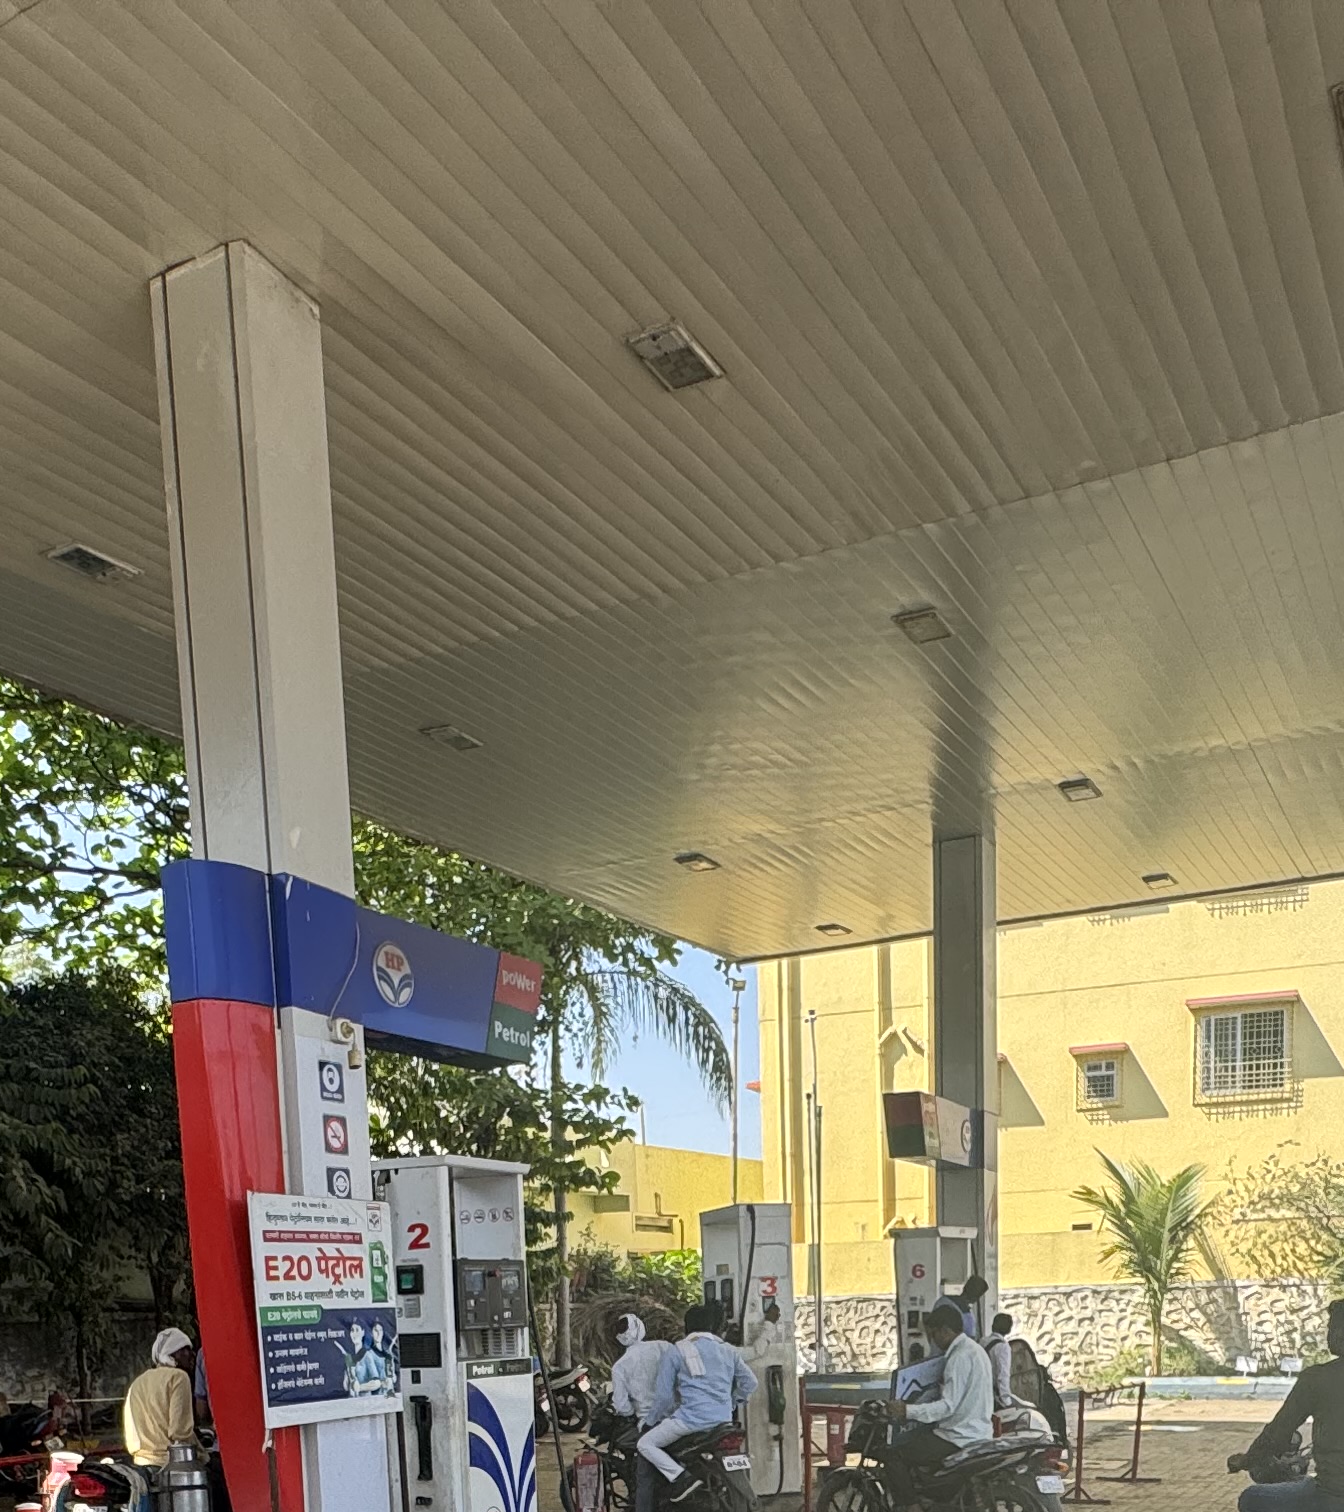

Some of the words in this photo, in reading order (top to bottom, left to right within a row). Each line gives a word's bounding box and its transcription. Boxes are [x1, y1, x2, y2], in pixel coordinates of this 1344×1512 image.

[383, 951, 405, 971] HP
[494, 1020, 531, 1048] Petrol
[406, 1223, 431, 1251] 2
[264, 1255, 313, 1281] E20
[315, 1247, 364, 1285] पेट्रोल
[911, 1263, 926, 1280] 6
[759, 1276, 778, 1295] 3
[472, 1363, 495, 1377] Petrol
